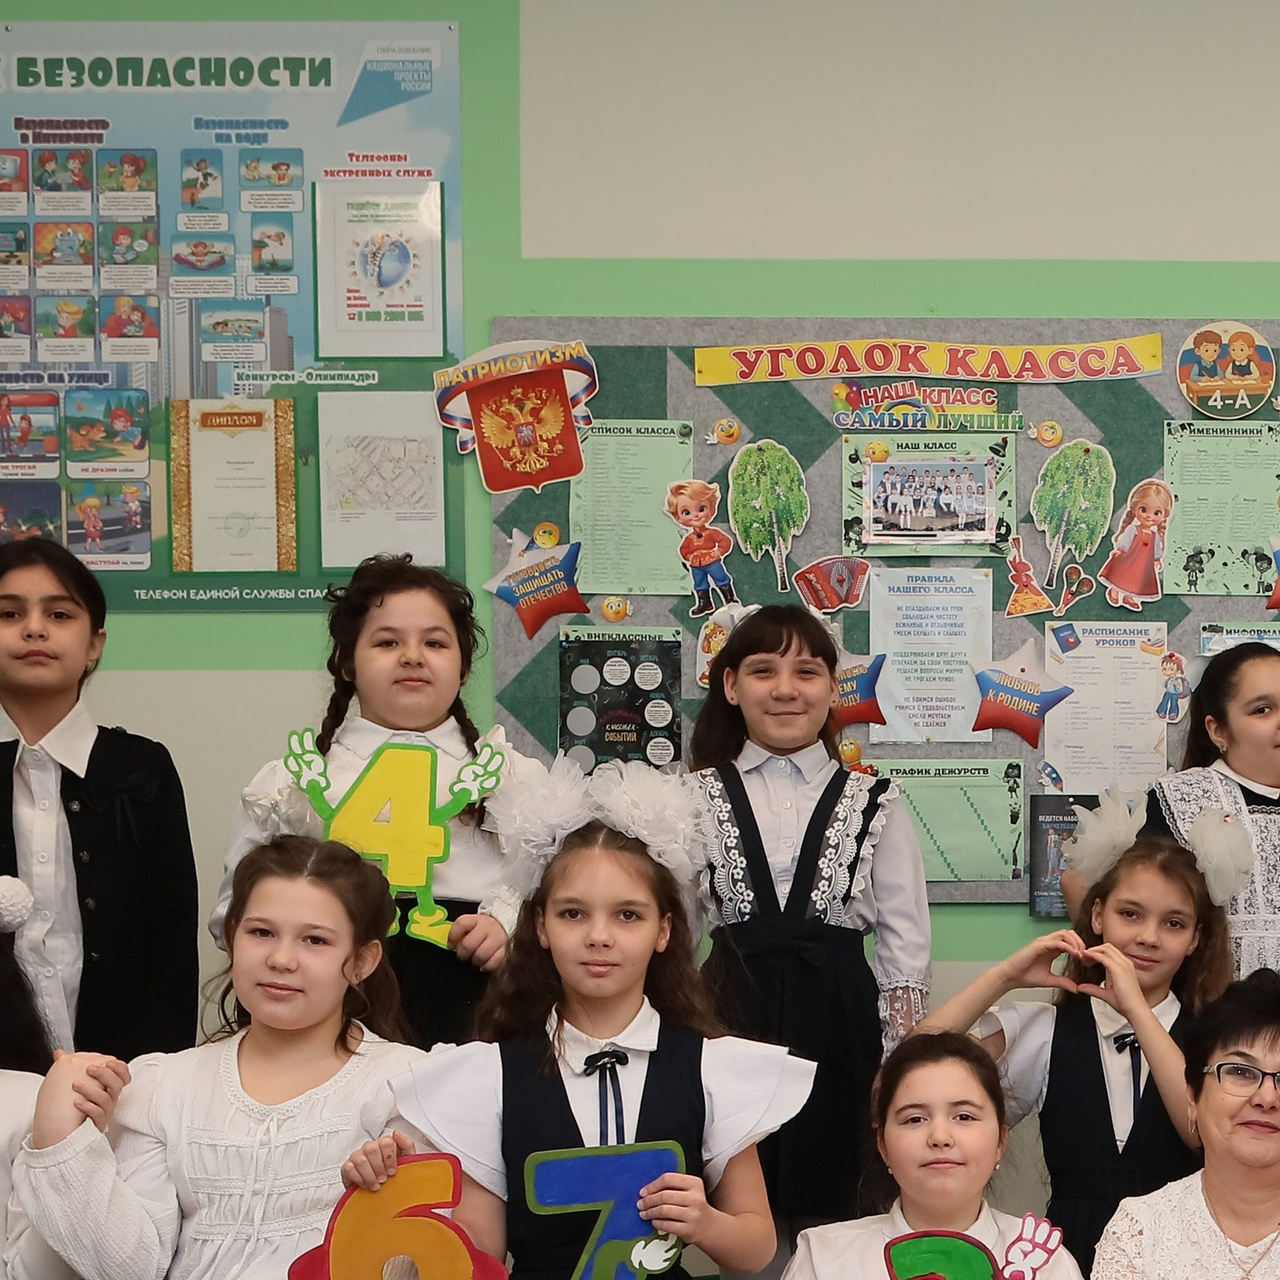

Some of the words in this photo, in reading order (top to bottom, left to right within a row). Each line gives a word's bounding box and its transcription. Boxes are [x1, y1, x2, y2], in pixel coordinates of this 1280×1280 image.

[16, 57, 332, 87] БЕЗОПАСНОСТИ
[366, 62, 430, 72] НАЦИОНАЛЬНЫЕ
[394, 72, 430, 81] ПРОЕКТЫ
[401, 81, 431, 91] РОССИИ
[435, 341, 586, 388] ПАТРИОТИЗМ
[732, 342, 931, 382] УГОЛОК
[943, 344, 1143, 380] КЛАССА
[862, 381, 916, 407] НАШ
[921, 388, 997, 406] КЛАСС
[1208, 389, 1252, 409] 4-А
[207, 416, 257, 426] ДИПЛОМ
[834, 409, 929, 429] САМЫЙ
[936, 410, 1025, 431] ЛУЧШИЙ
[591, 426, 632, 435] СПИСОК
[636, 426, 675, 435] КЛАССА
[513, 569, 564, 596] ЗАЩИЩАТЬ
[134, 589, 187, 599] ТЕЛЕФОН
[190, 587, 240, 600] ЕДИНОЙ
[243, 589, 295, 599] СЛУЖБЫ
[519, 581, 568, 608] ОТЕЧЕСТВО
[587, 633, 663, 641] ВНЕКЛАССНЫЕ
[1082, 628, 1149, 636] РАСПИСАНИЕ
[996, 673, 1041, 696] ЛЮБОВЬ
[987, 688, 994, 701] К
[997, 691, 1041, 716] РОДИНЕ
[605, 731, 637, 742] СОБЫТИЙ
[889, 767, 929, 777] ГРАФИК
[933, 766, 989, 778] ДЕЖУРСТВ
[325, 743, 450, 893] 4
